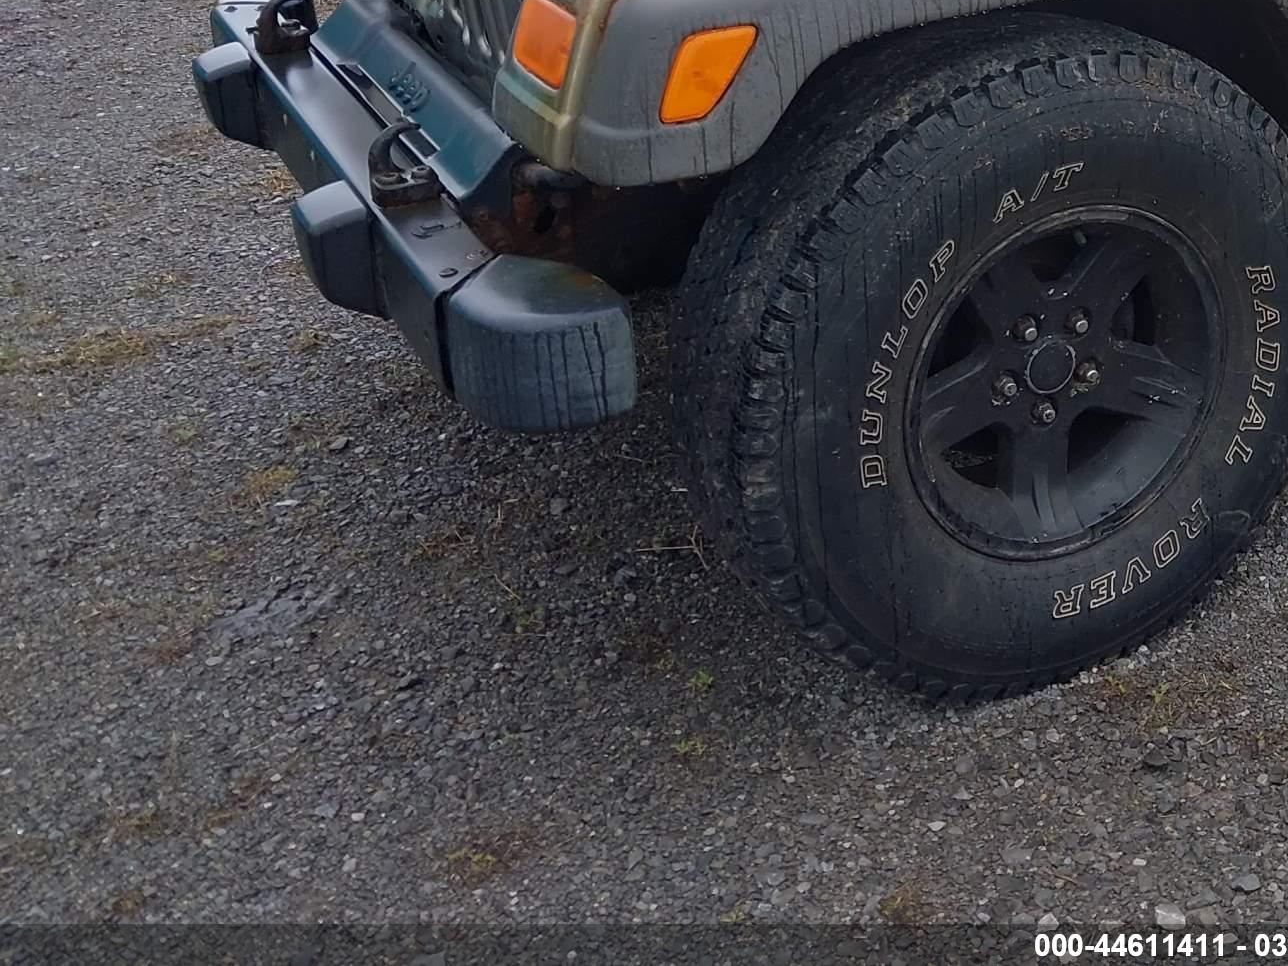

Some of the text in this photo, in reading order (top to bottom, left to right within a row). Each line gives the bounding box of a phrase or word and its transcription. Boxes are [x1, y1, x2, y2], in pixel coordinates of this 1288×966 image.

[860, 162, 1084, 489] DUNLOP A/T
[1052, 265, 1281, 620] RADIAL ROVER
